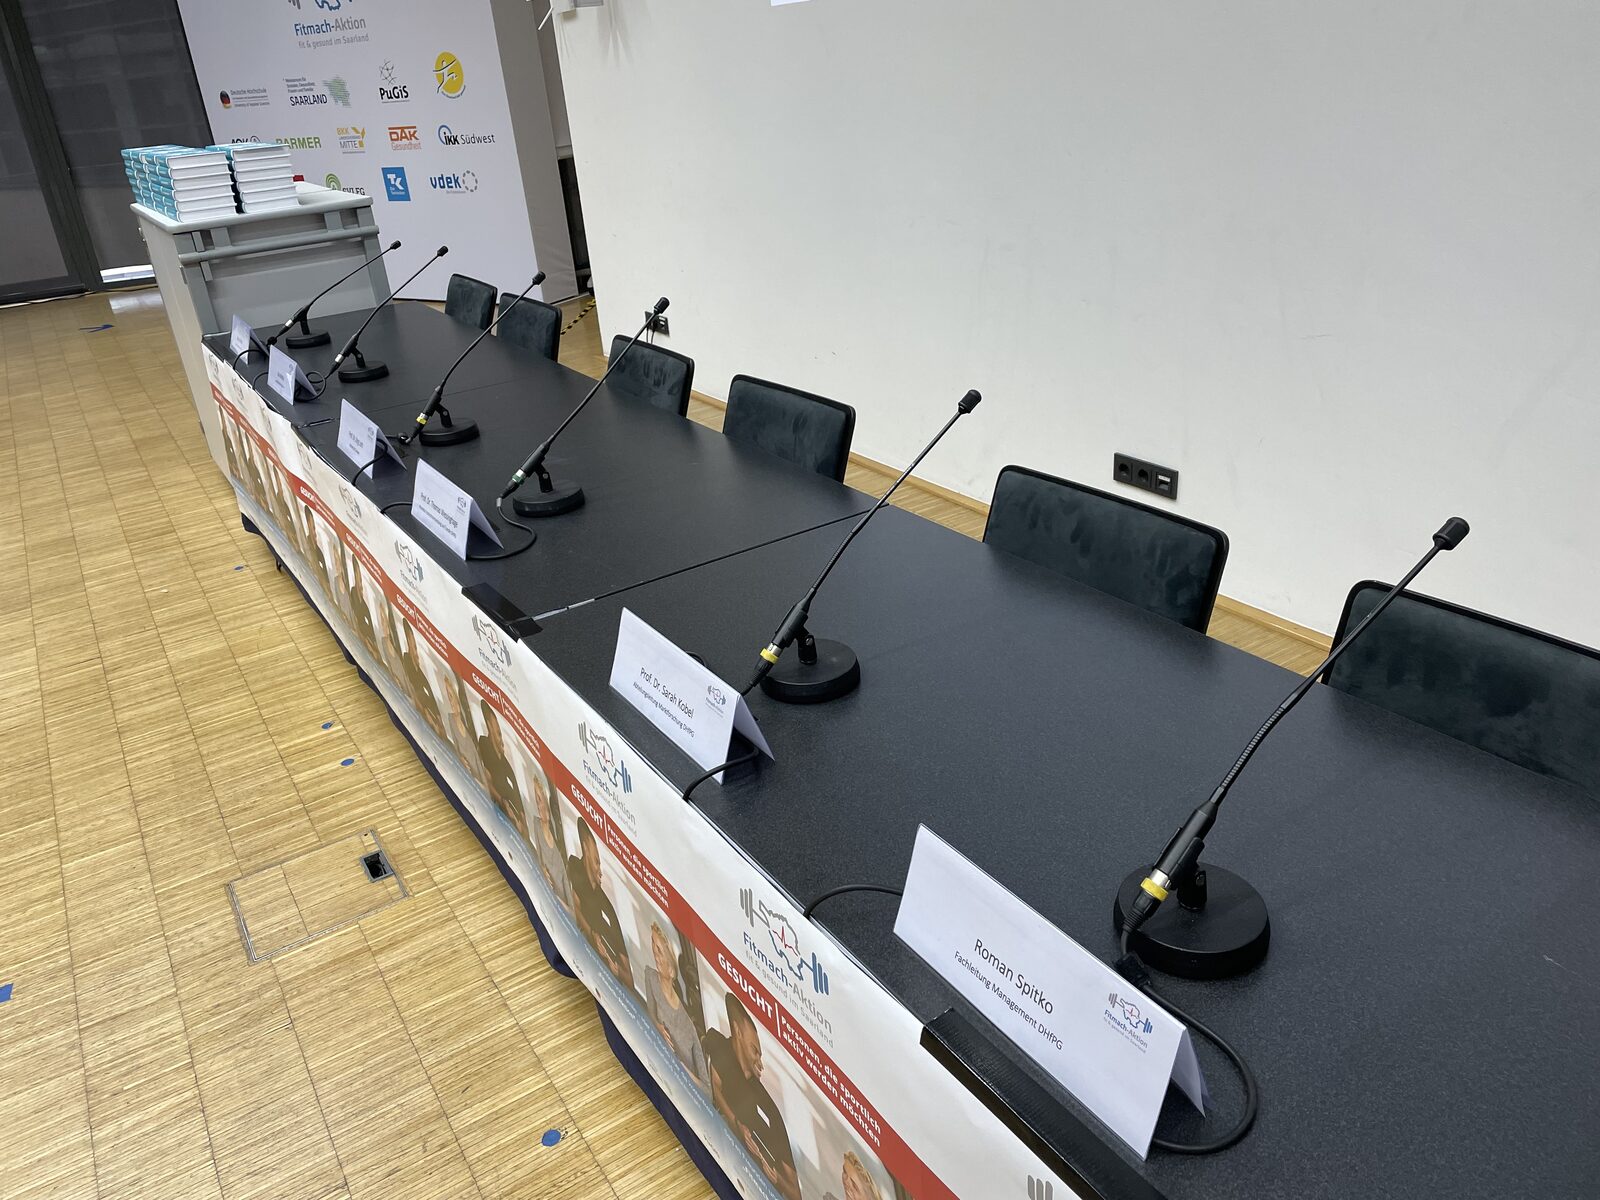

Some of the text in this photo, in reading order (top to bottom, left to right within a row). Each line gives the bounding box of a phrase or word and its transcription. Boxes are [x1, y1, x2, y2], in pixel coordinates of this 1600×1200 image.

[294, 16, 367, 36] Fitmach-Aktion
[312, 38, 333, 49] gesund
[334, 37, 342, 45] im
[343, 33, 370, 44] Saarland
[289, 94, 328, 106] SAARLAND
[339, 141, 359, 149] MITTE
[388, 126, 420, 141] DAK
[391, 142, 422, 151] Gesundheit
[460, 133, 496, 146] Südwest
[387, 173, 405, 190] TK
[430, 173, 462, 189] vdek
[640, 667, 653, 685] Prof.
[653, 678, 661, 692] Dr.
[661, 685, 678, 705] Sarah
[678, 698, 695, 719] Kobel
[571, 784, 605, 830] GESUCHT
[718, 952, 774, 1020] GESUCHT
[743, 931, 833, 1034] Fitmach-Aktion
[974, 938, 1054, 1015] Roman Spitko
[762, 969, 789, 999] gesund
[800, 1006, 834, 1049] Saarland
[954, 950, 992, 990] Fachleitung
[991, 983, 1037, 1029] Management
[1037, 1023, 1064, 1051] DHfPG
[781, 1015, 881, 1135] Personen, die sportlich
[782, 1031, 881, 1147] aktiv werden möchten
